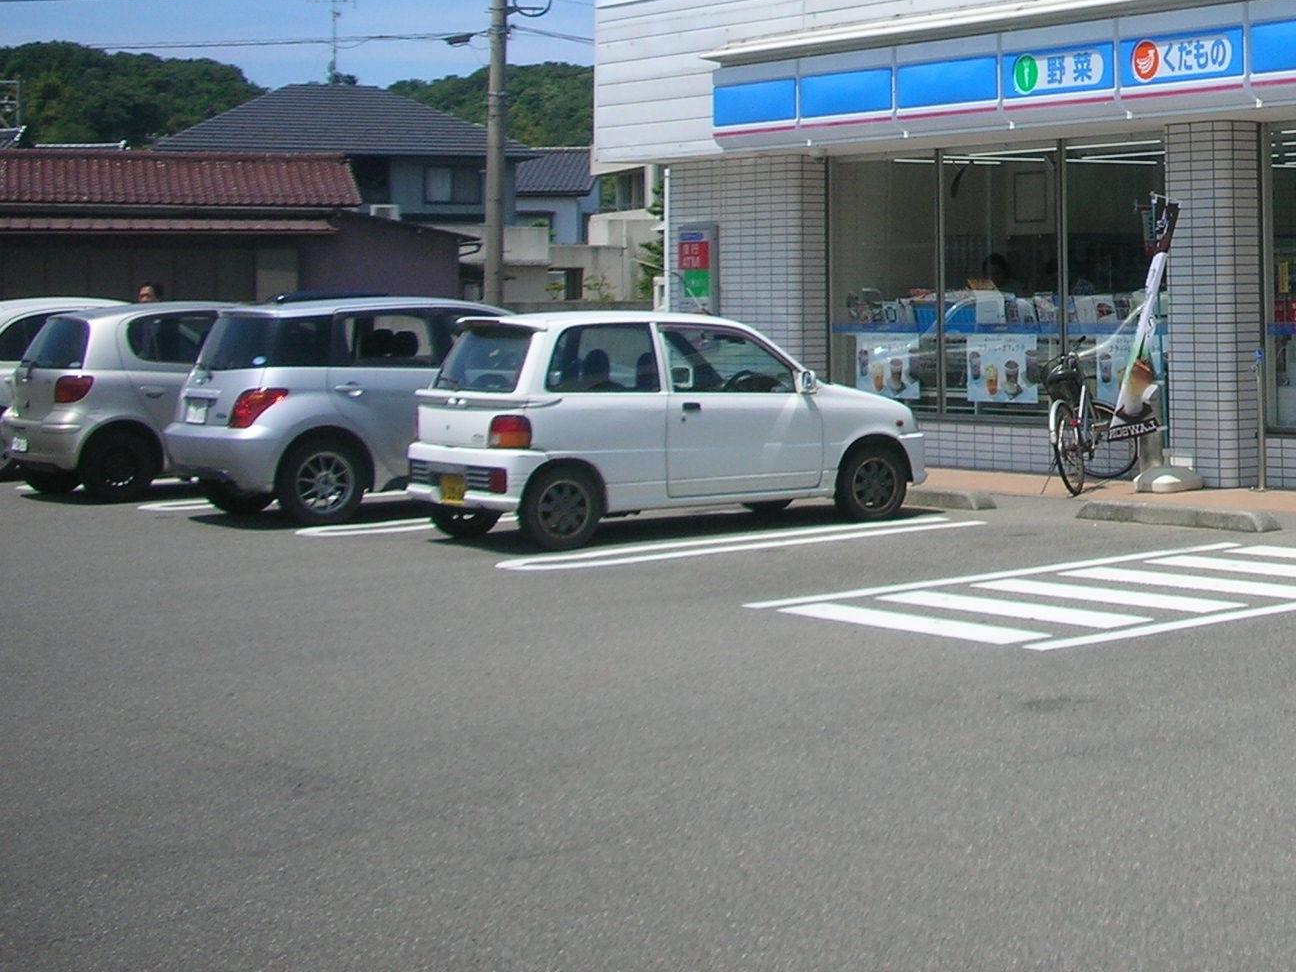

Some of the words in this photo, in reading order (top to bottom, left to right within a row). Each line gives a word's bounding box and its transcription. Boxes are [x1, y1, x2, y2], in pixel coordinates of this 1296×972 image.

[1046, 52, 1095, 85] 野菜
[1162, 37, 1227, 72] くだもの
